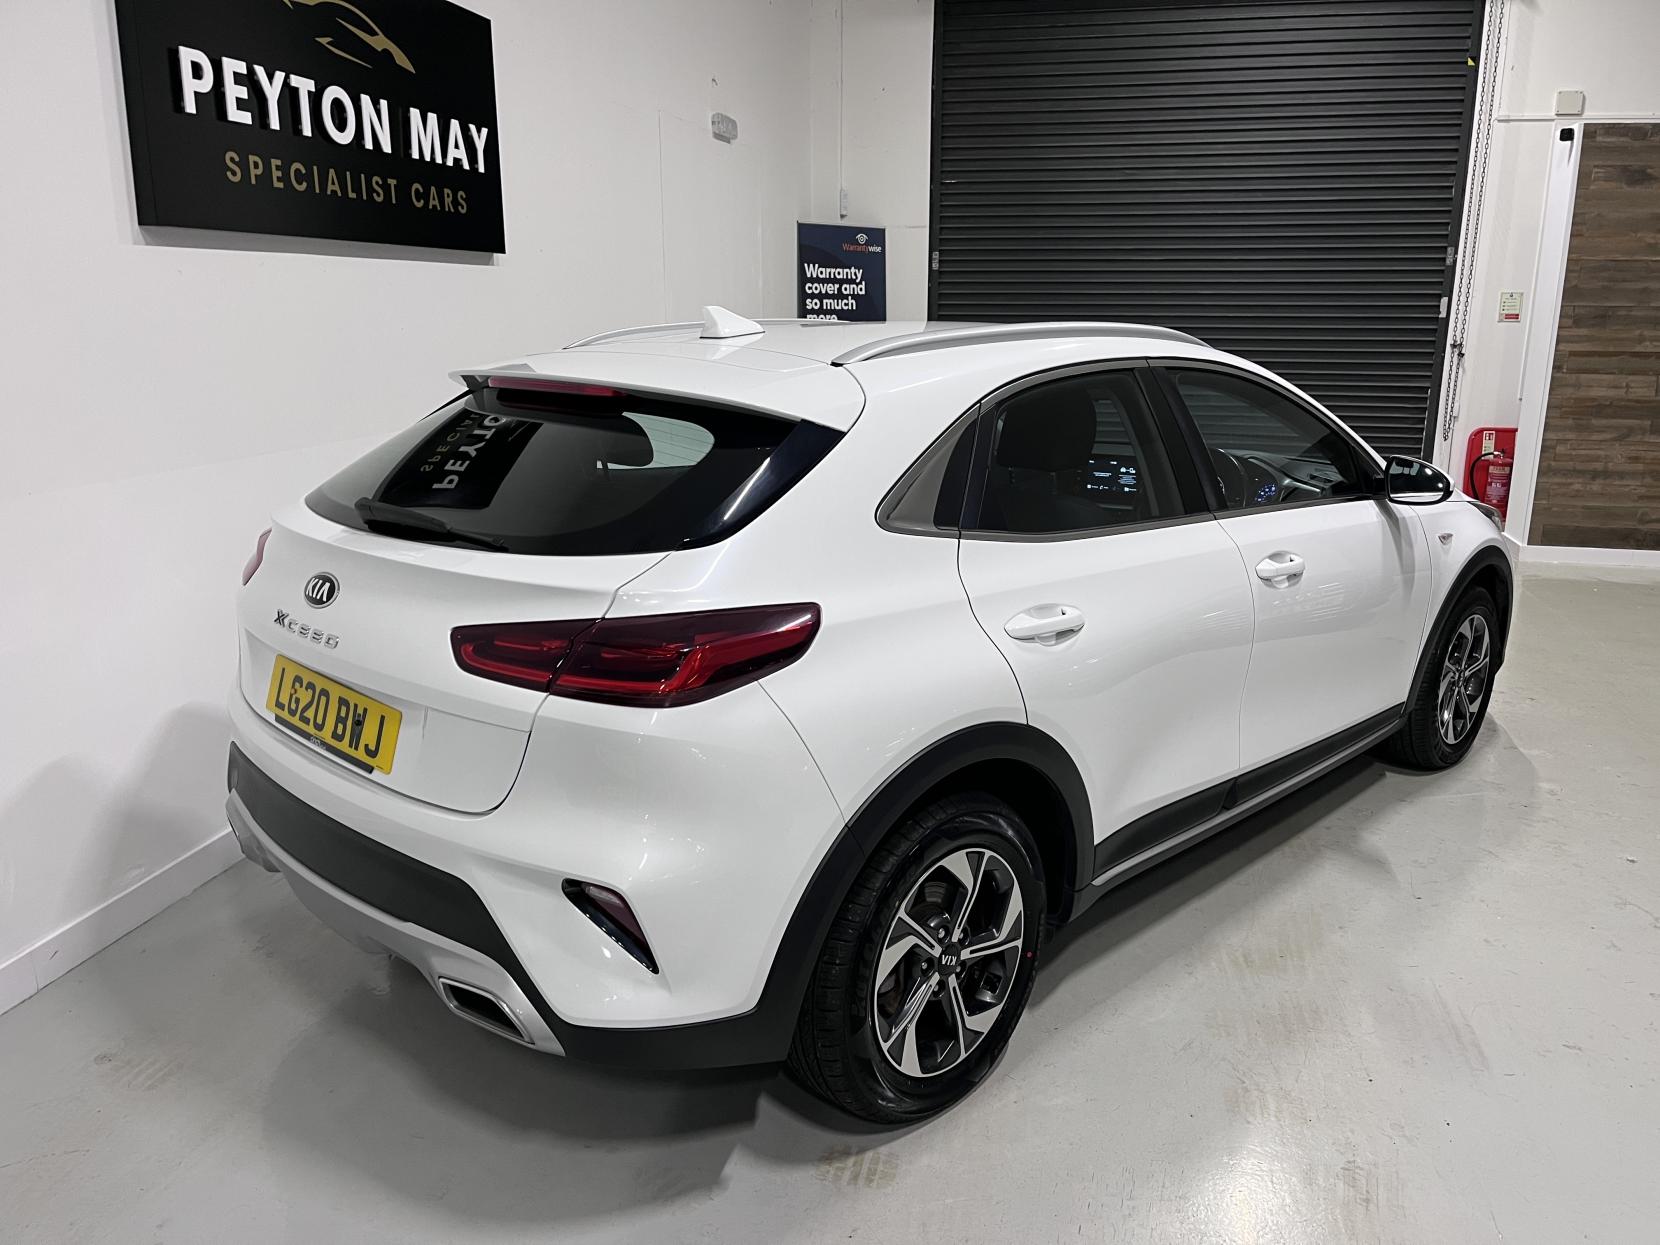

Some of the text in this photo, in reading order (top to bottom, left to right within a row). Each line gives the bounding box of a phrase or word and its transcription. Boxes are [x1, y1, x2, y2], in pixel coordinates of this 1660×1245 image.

[178, 45, 489, 174] PEYTON MAY
[224, 151, 468, 214] SPECIALIST CARS
[804, 263, 863, 283] Warranty
[805, 281, 866, 295] cover and
[806, 296, 856, 310] so much
[306, 577, 331, 602] KIA
[274, 667, 386, 759] LG20 BWJ
